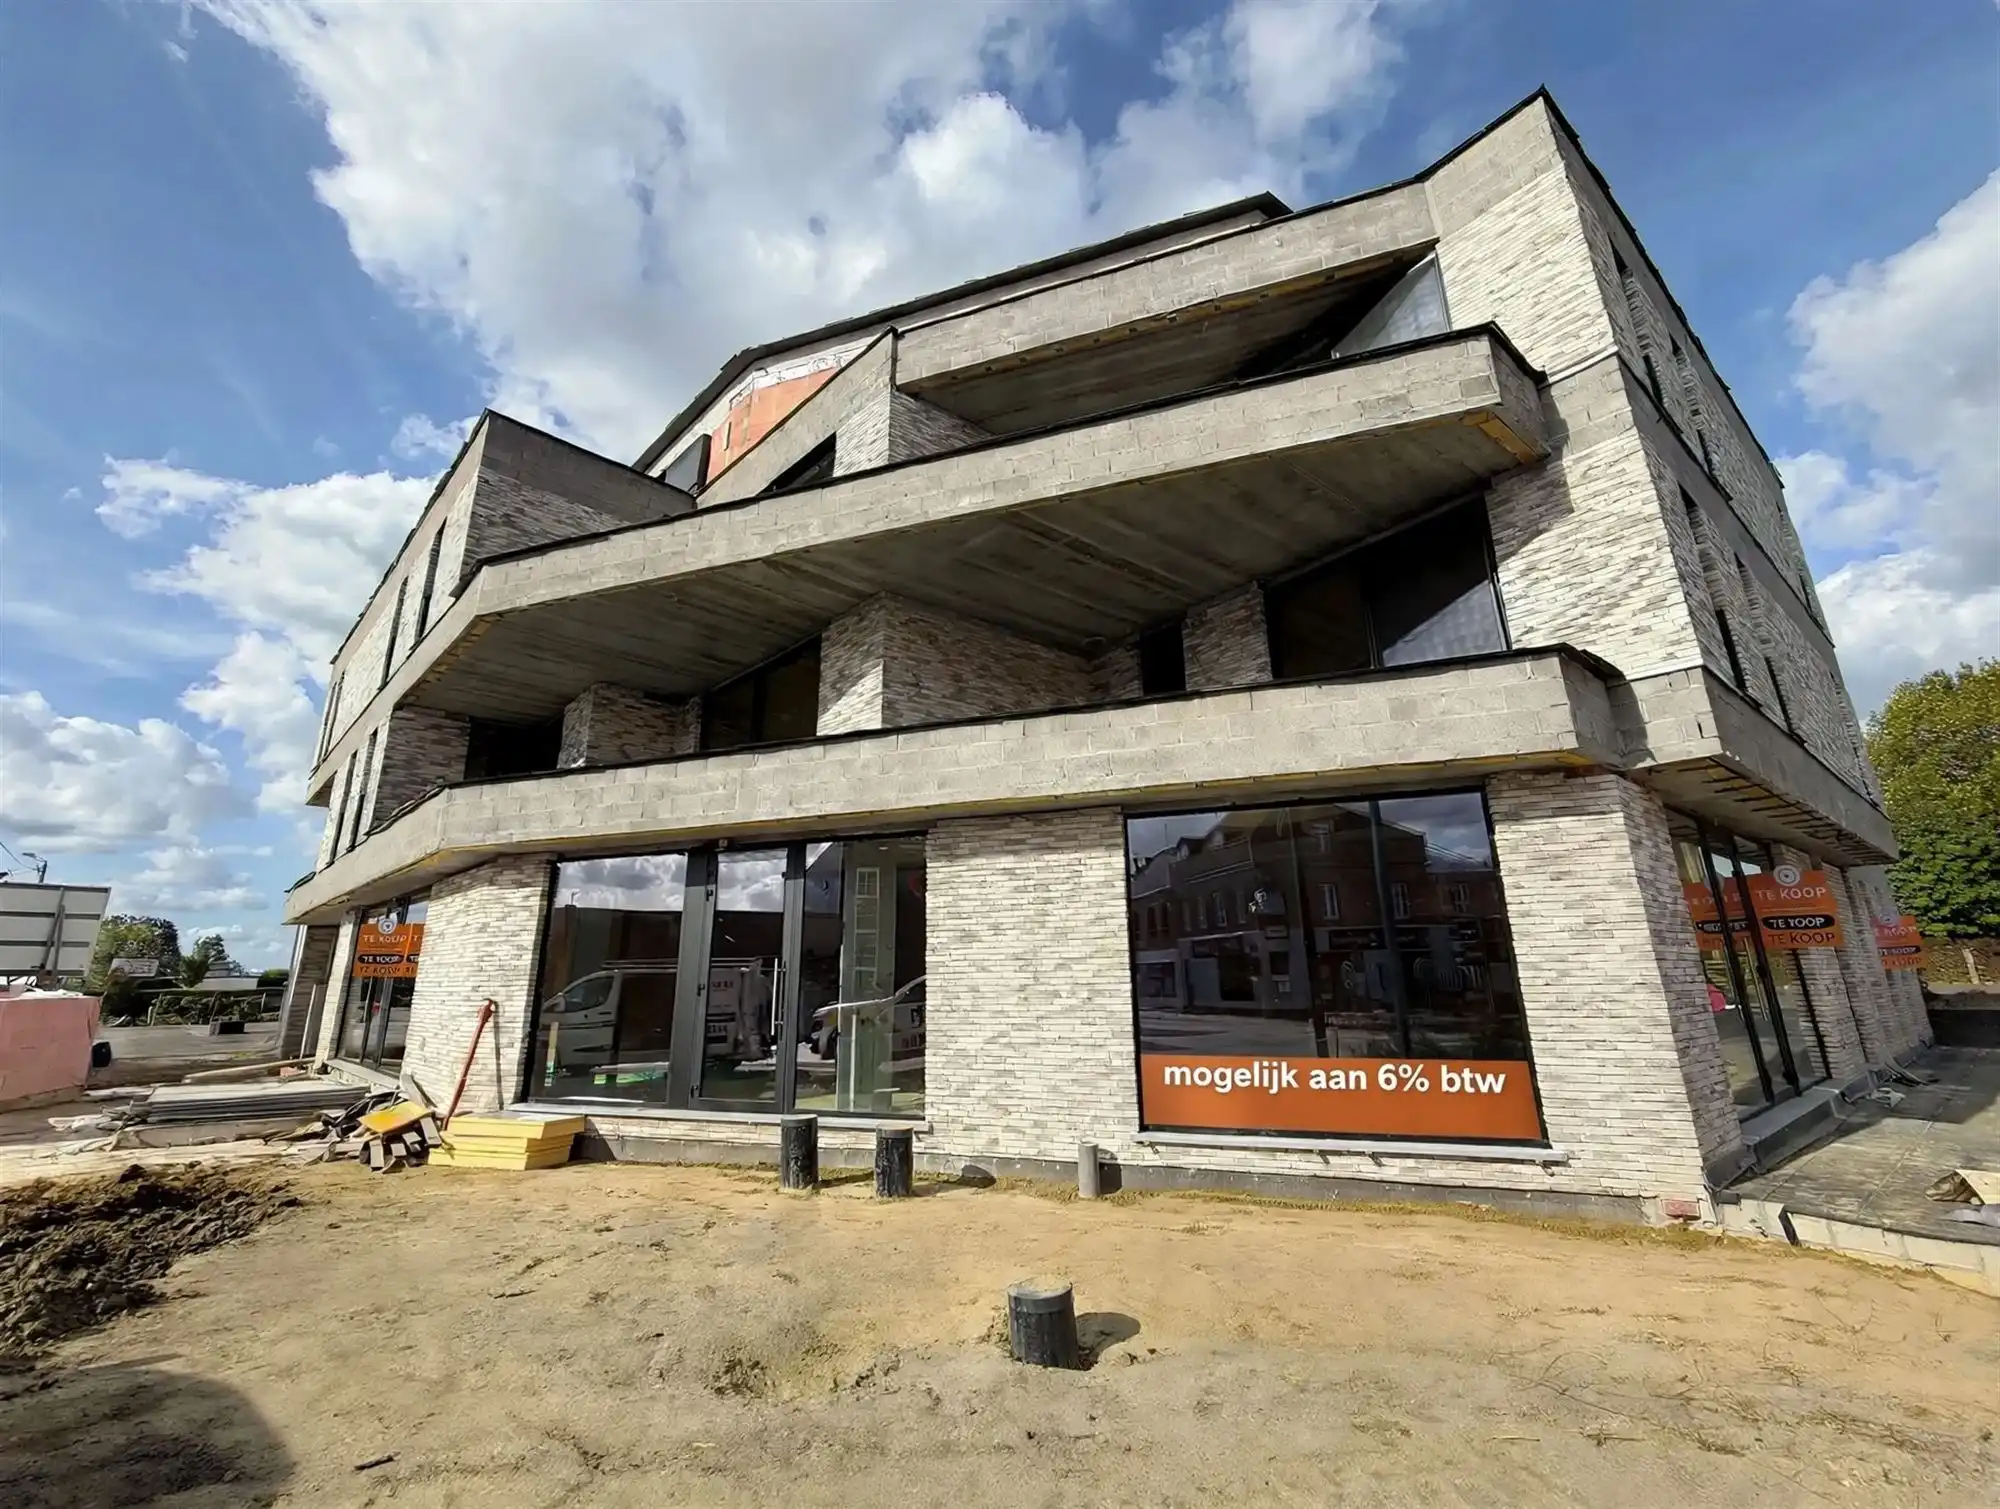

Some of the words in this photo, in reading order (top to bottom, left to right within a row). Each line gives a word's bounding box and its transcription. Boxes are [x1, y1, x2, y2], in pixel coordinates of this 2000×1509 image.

[1756, 890, 1776, 901] TE
[1780, 887, 1826, 900] KOOP
[1768, 934, 1785, 944] TE
[1789, 932, 1835, 944] KOOP
[1164, 1061, 1299, 1094] mogelijk
[1309, 1069, 1367, 1091] aan
[1378, 1063, 1429, 1092] 6%
[1441, 1065, 1506, 1094] btw
